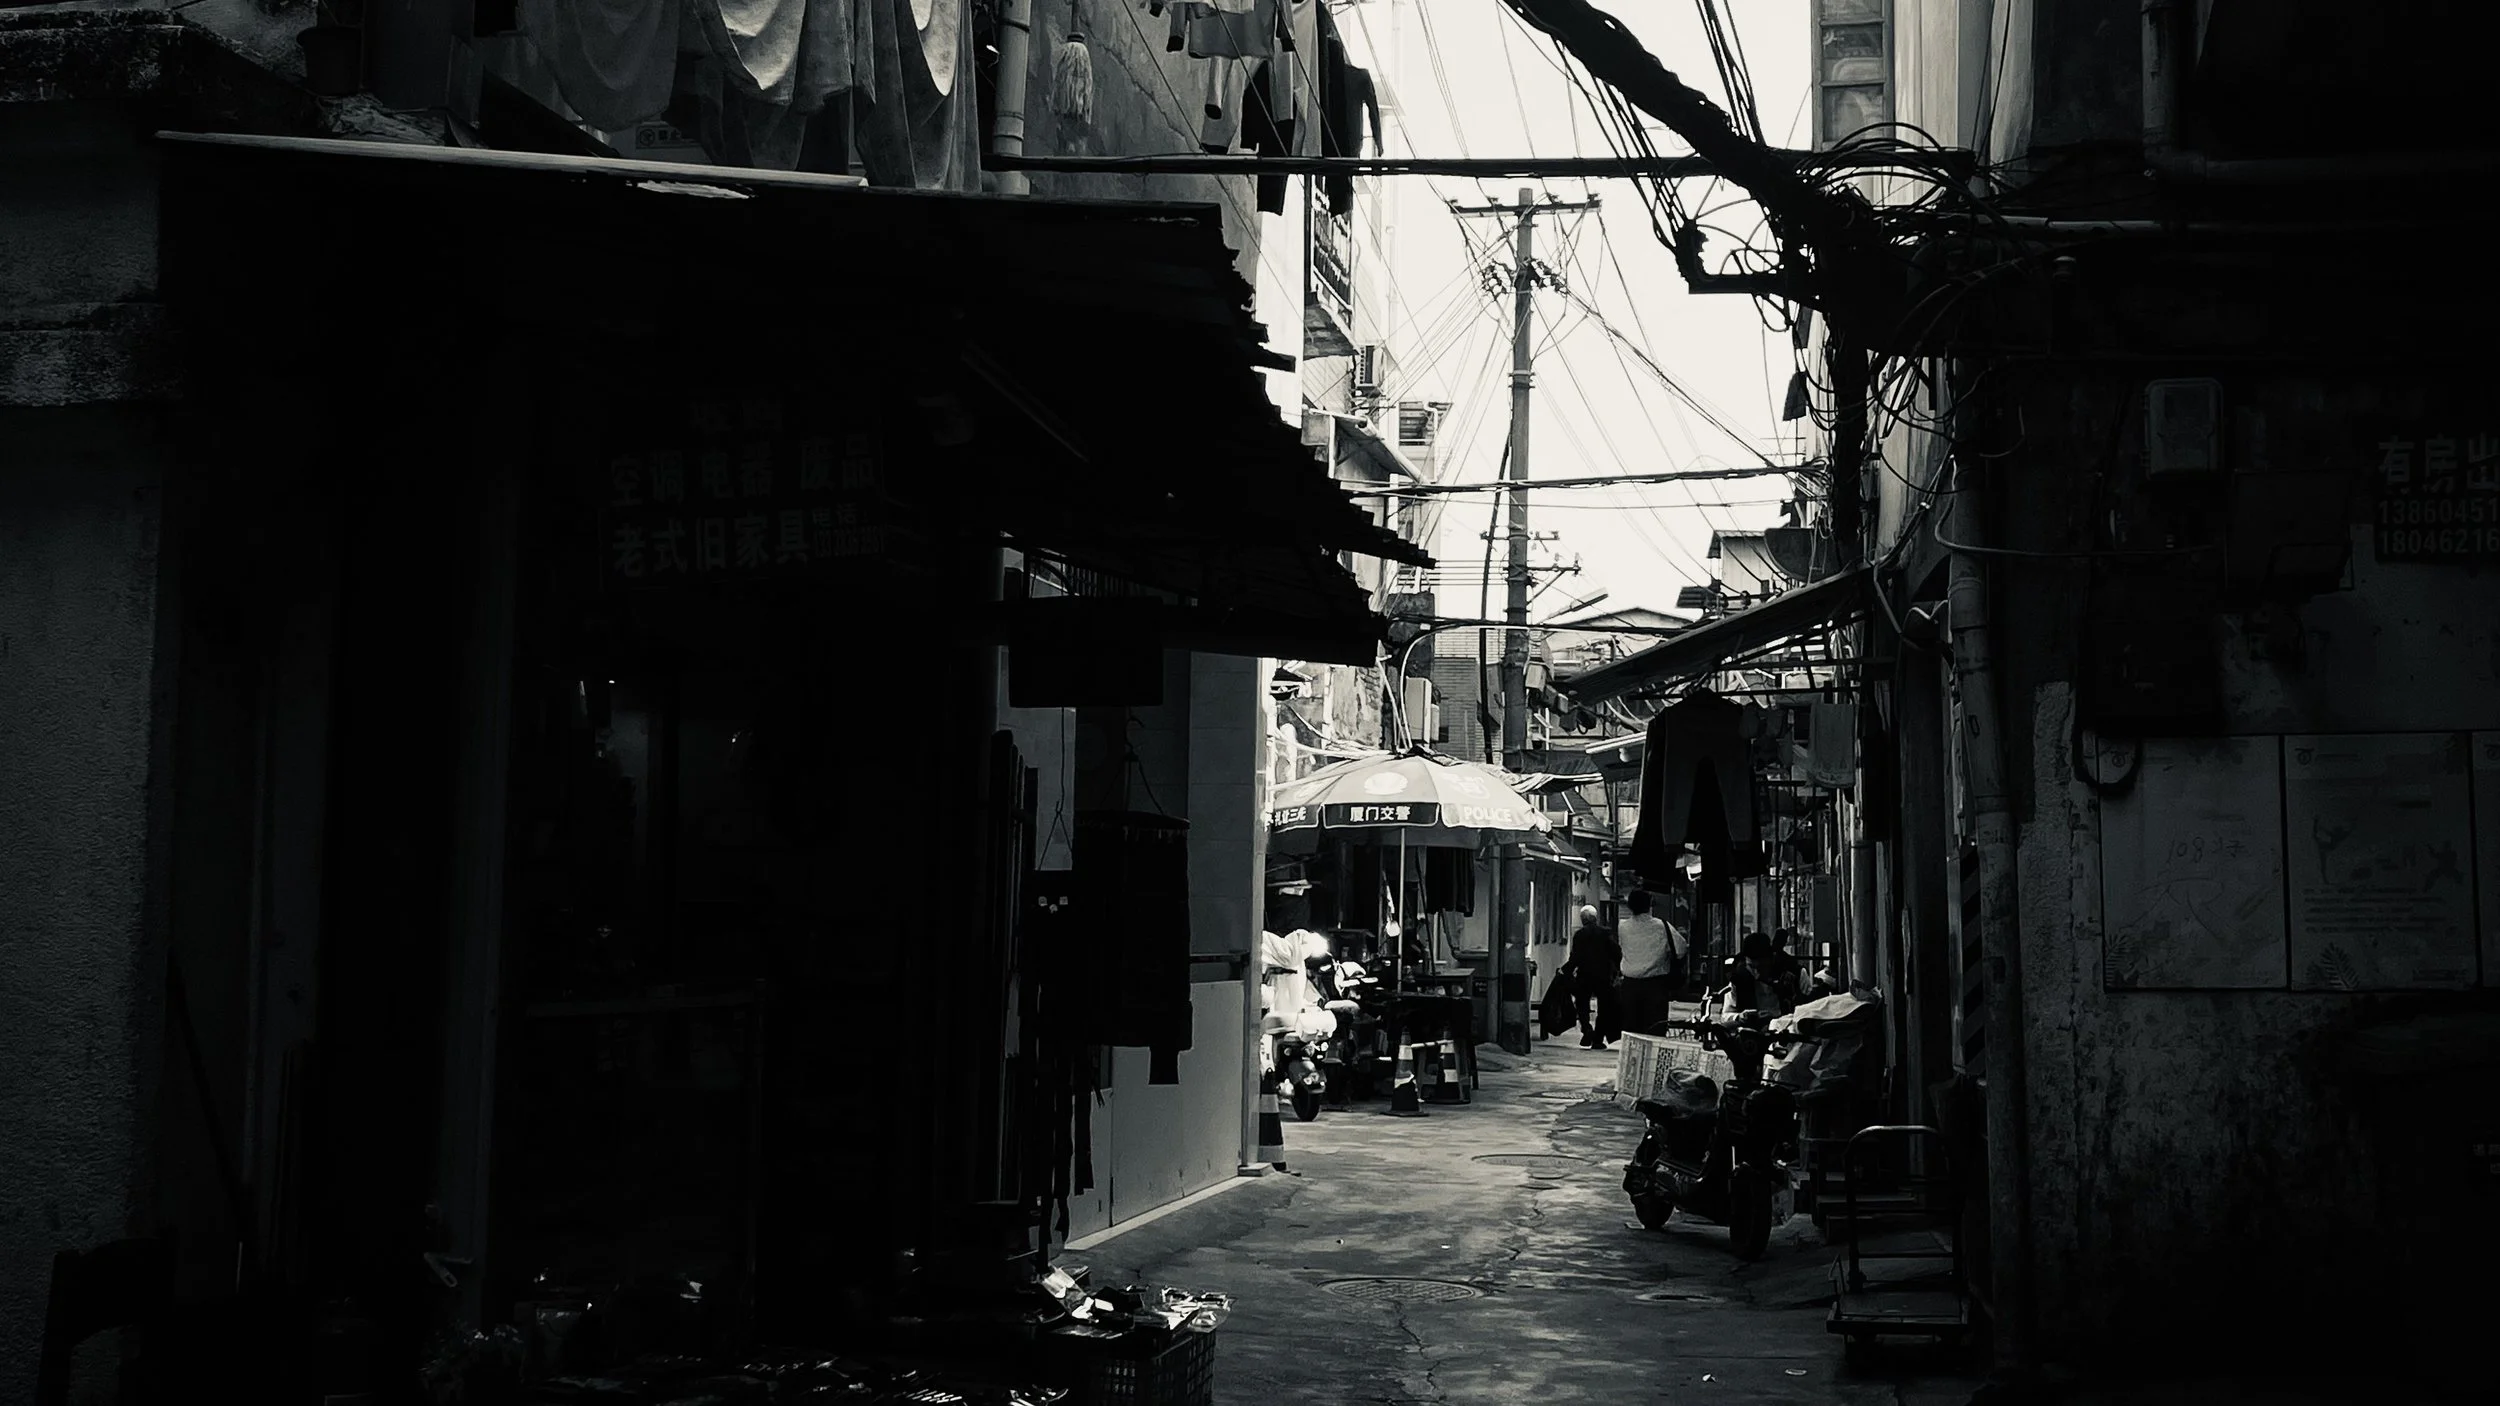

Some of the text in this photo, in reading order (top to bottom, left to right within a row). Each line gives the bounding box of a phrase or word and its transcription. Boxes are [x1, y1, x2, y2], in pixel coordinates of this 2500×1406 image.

[611, 509, 811, 579] 老式旧家具
[1349, 805, 1411, 822] 厦门交警
[1463, 806, 1513, 822] POLICE
